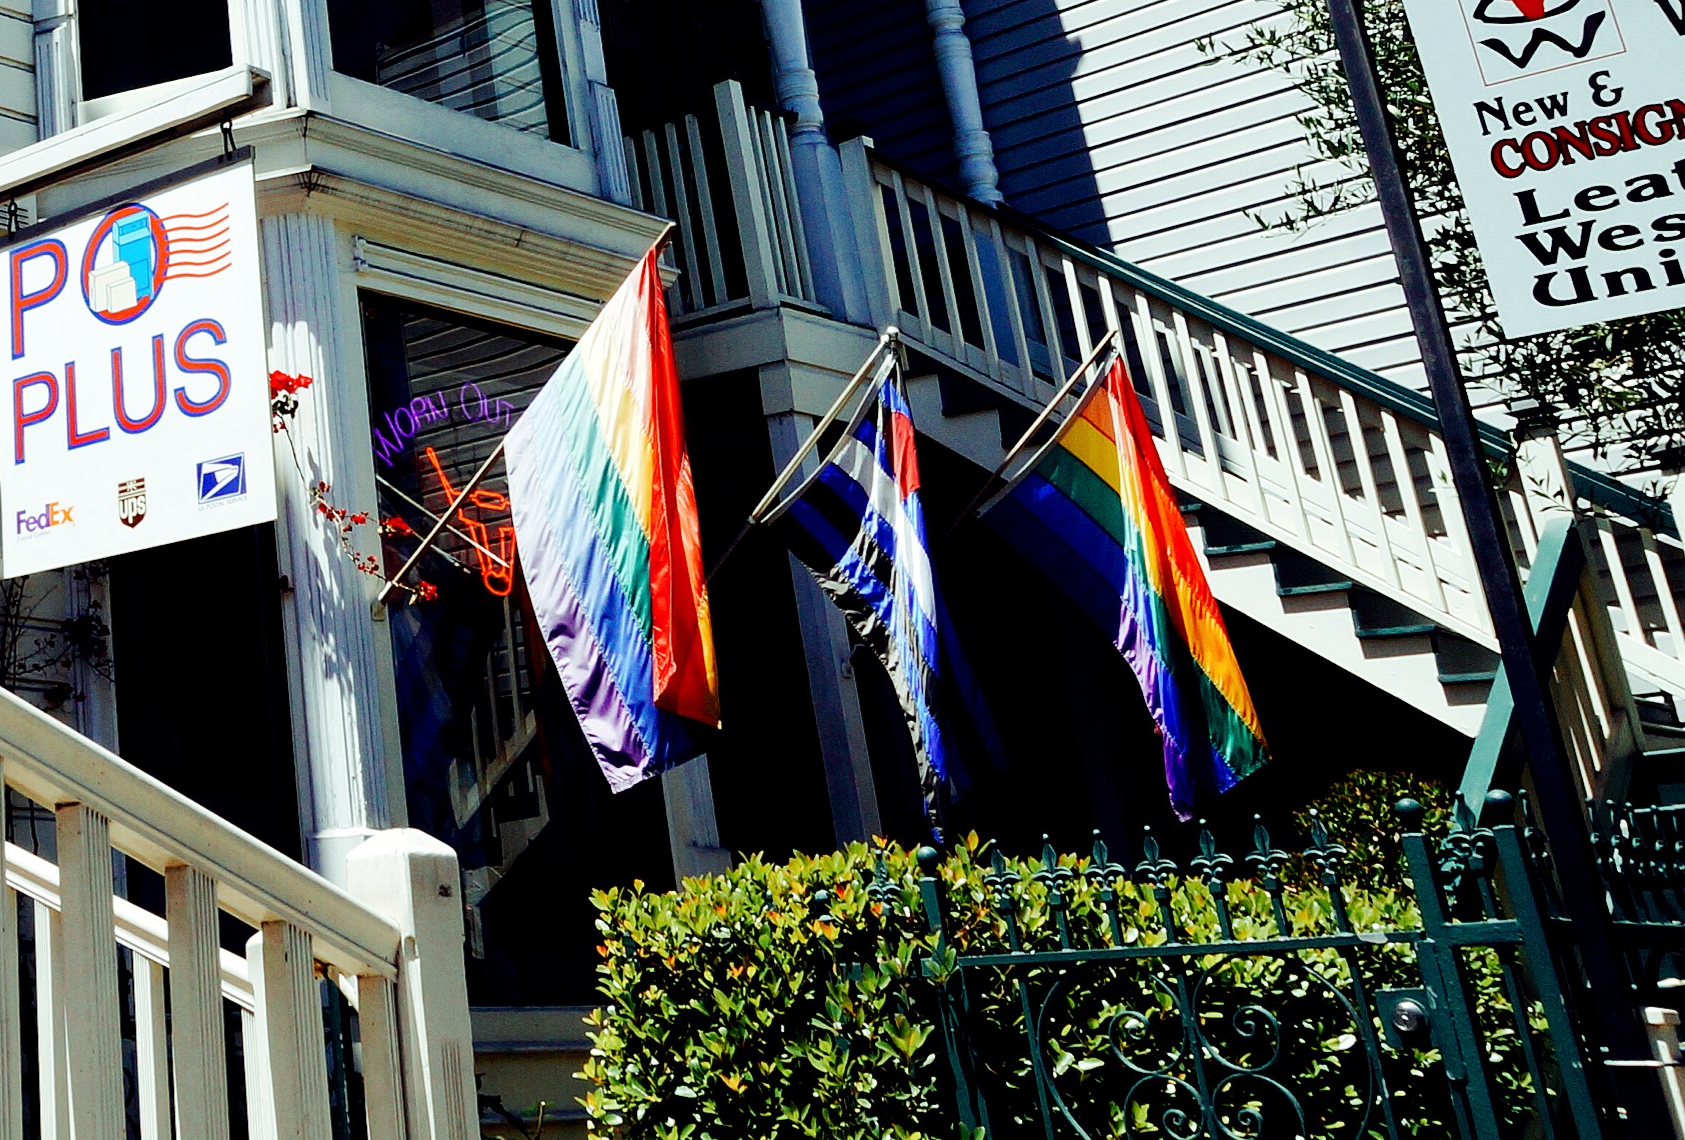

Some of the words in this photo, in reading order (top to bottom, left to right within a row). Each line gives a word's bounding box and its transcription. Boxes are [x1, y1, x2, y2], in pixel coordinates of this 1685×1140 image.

[1473, 91, 1569, 136] New
[1589, 70, 1624, 108] &
[1514, 213, 1685, 267] Wes
[8, 202, 170, 360] PO
[1532, 248, 1685, 307] Uni
[13, 318, 232, 466] PLUS
[372, 390, 449, 468] WORN
[460, 382, 515, 428] OUT
[16, 501, 74, 535] FedEx
